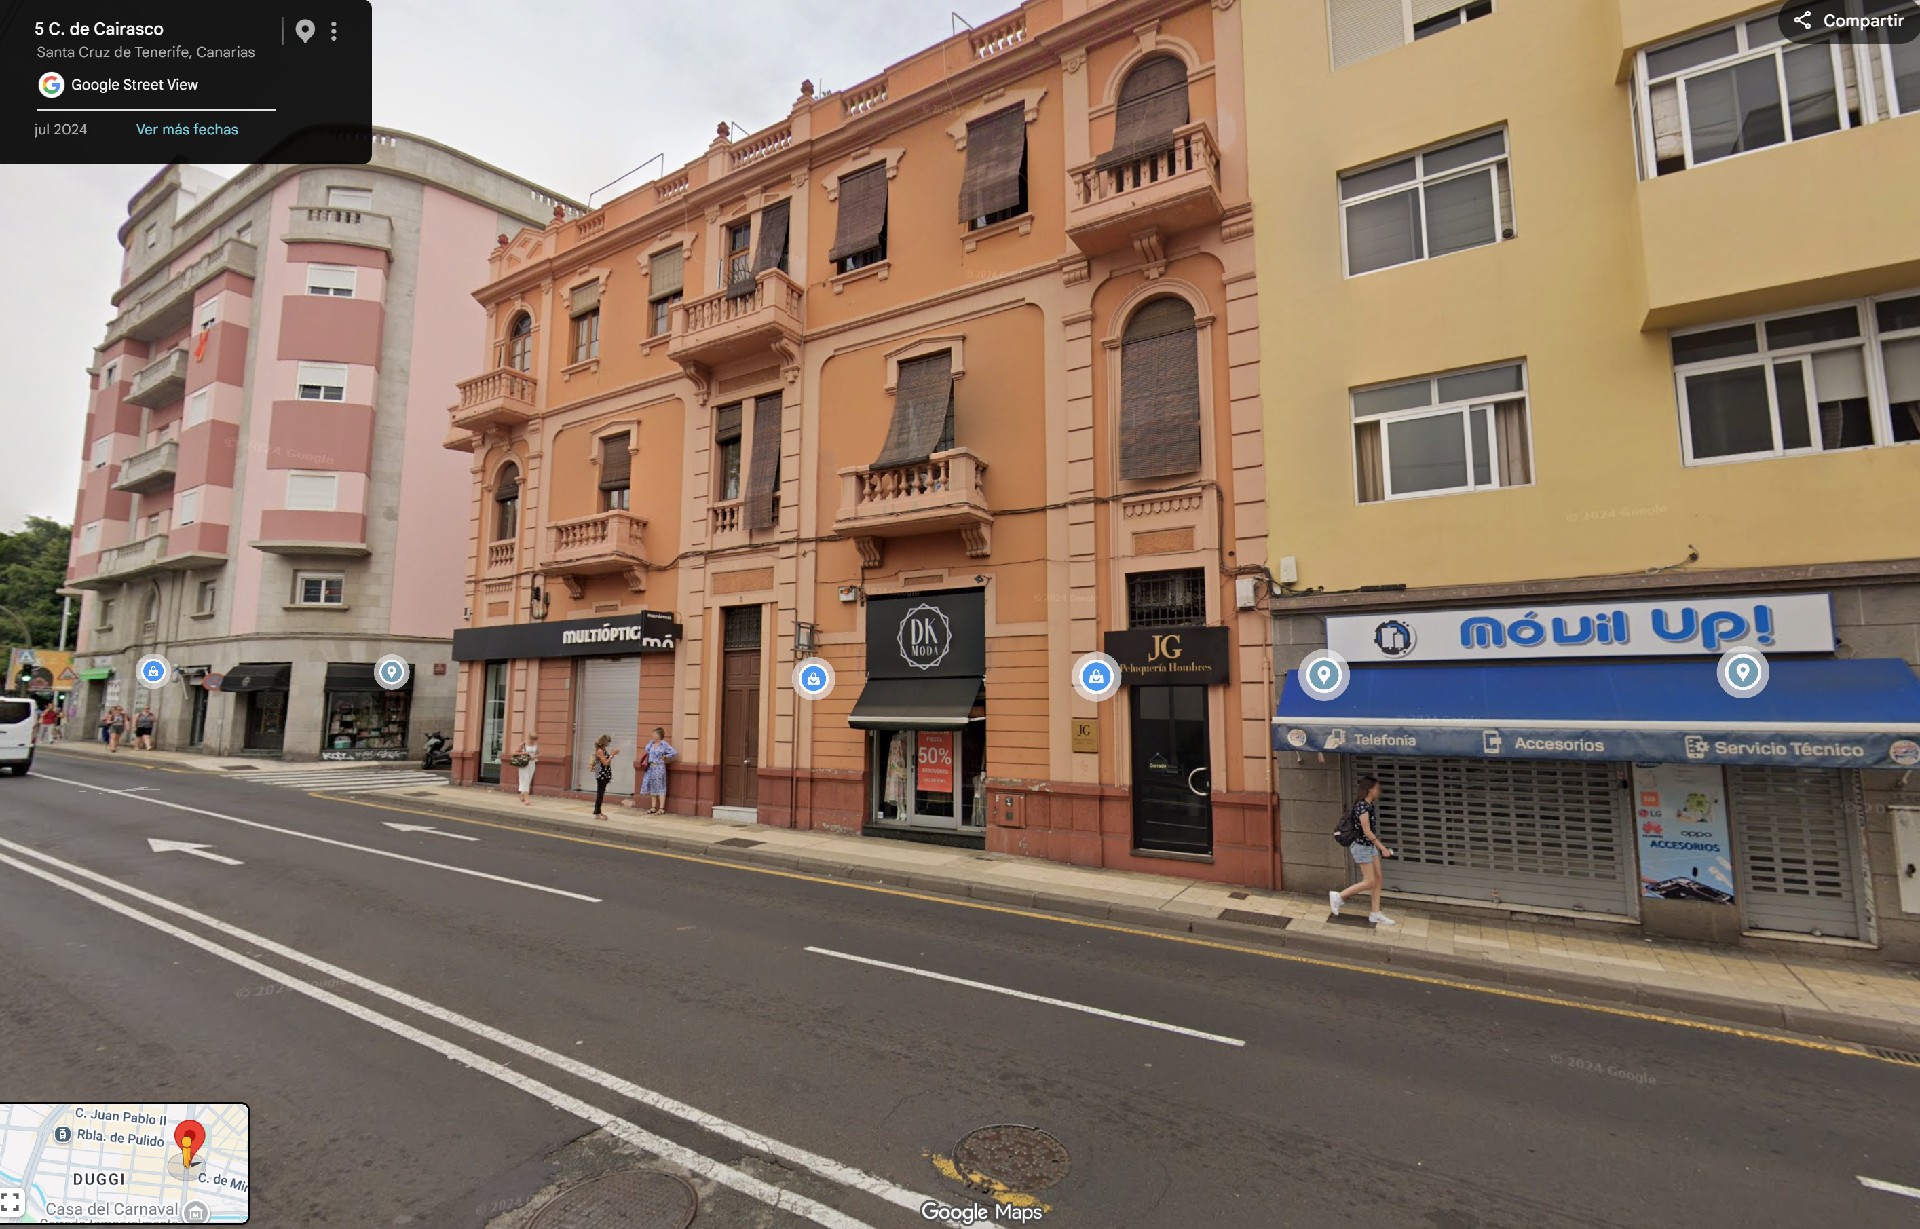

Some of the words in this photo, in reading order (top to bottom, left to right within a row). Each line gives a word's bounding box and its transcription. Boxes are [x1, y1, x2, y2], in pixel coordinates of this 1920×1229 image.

[562, 622, 642, 644] MULTIÓPTIC
[911, 617, 938, 645] DK
[1650, 604, 1776, 651] Up!
[911, 645, 939, 657] MODA
[1147, 634, 1183, 663] JG
[1119, 662, 1167, 676] Peluquería
[1168, 661, 1213, 673] Hombres
[1354, 733, 1417, 748] Telefonía
[1515, 737, 1605, 753] Accesorios
[918, 746, 952, 765] 50%
[1714, 741, 1787, 756] Servicio
[1790, 741, 1864, 757] Técnico
[1650, 810, 1662, 818] LG
[1650, 840, 1721, 853] ACCESORIOS
